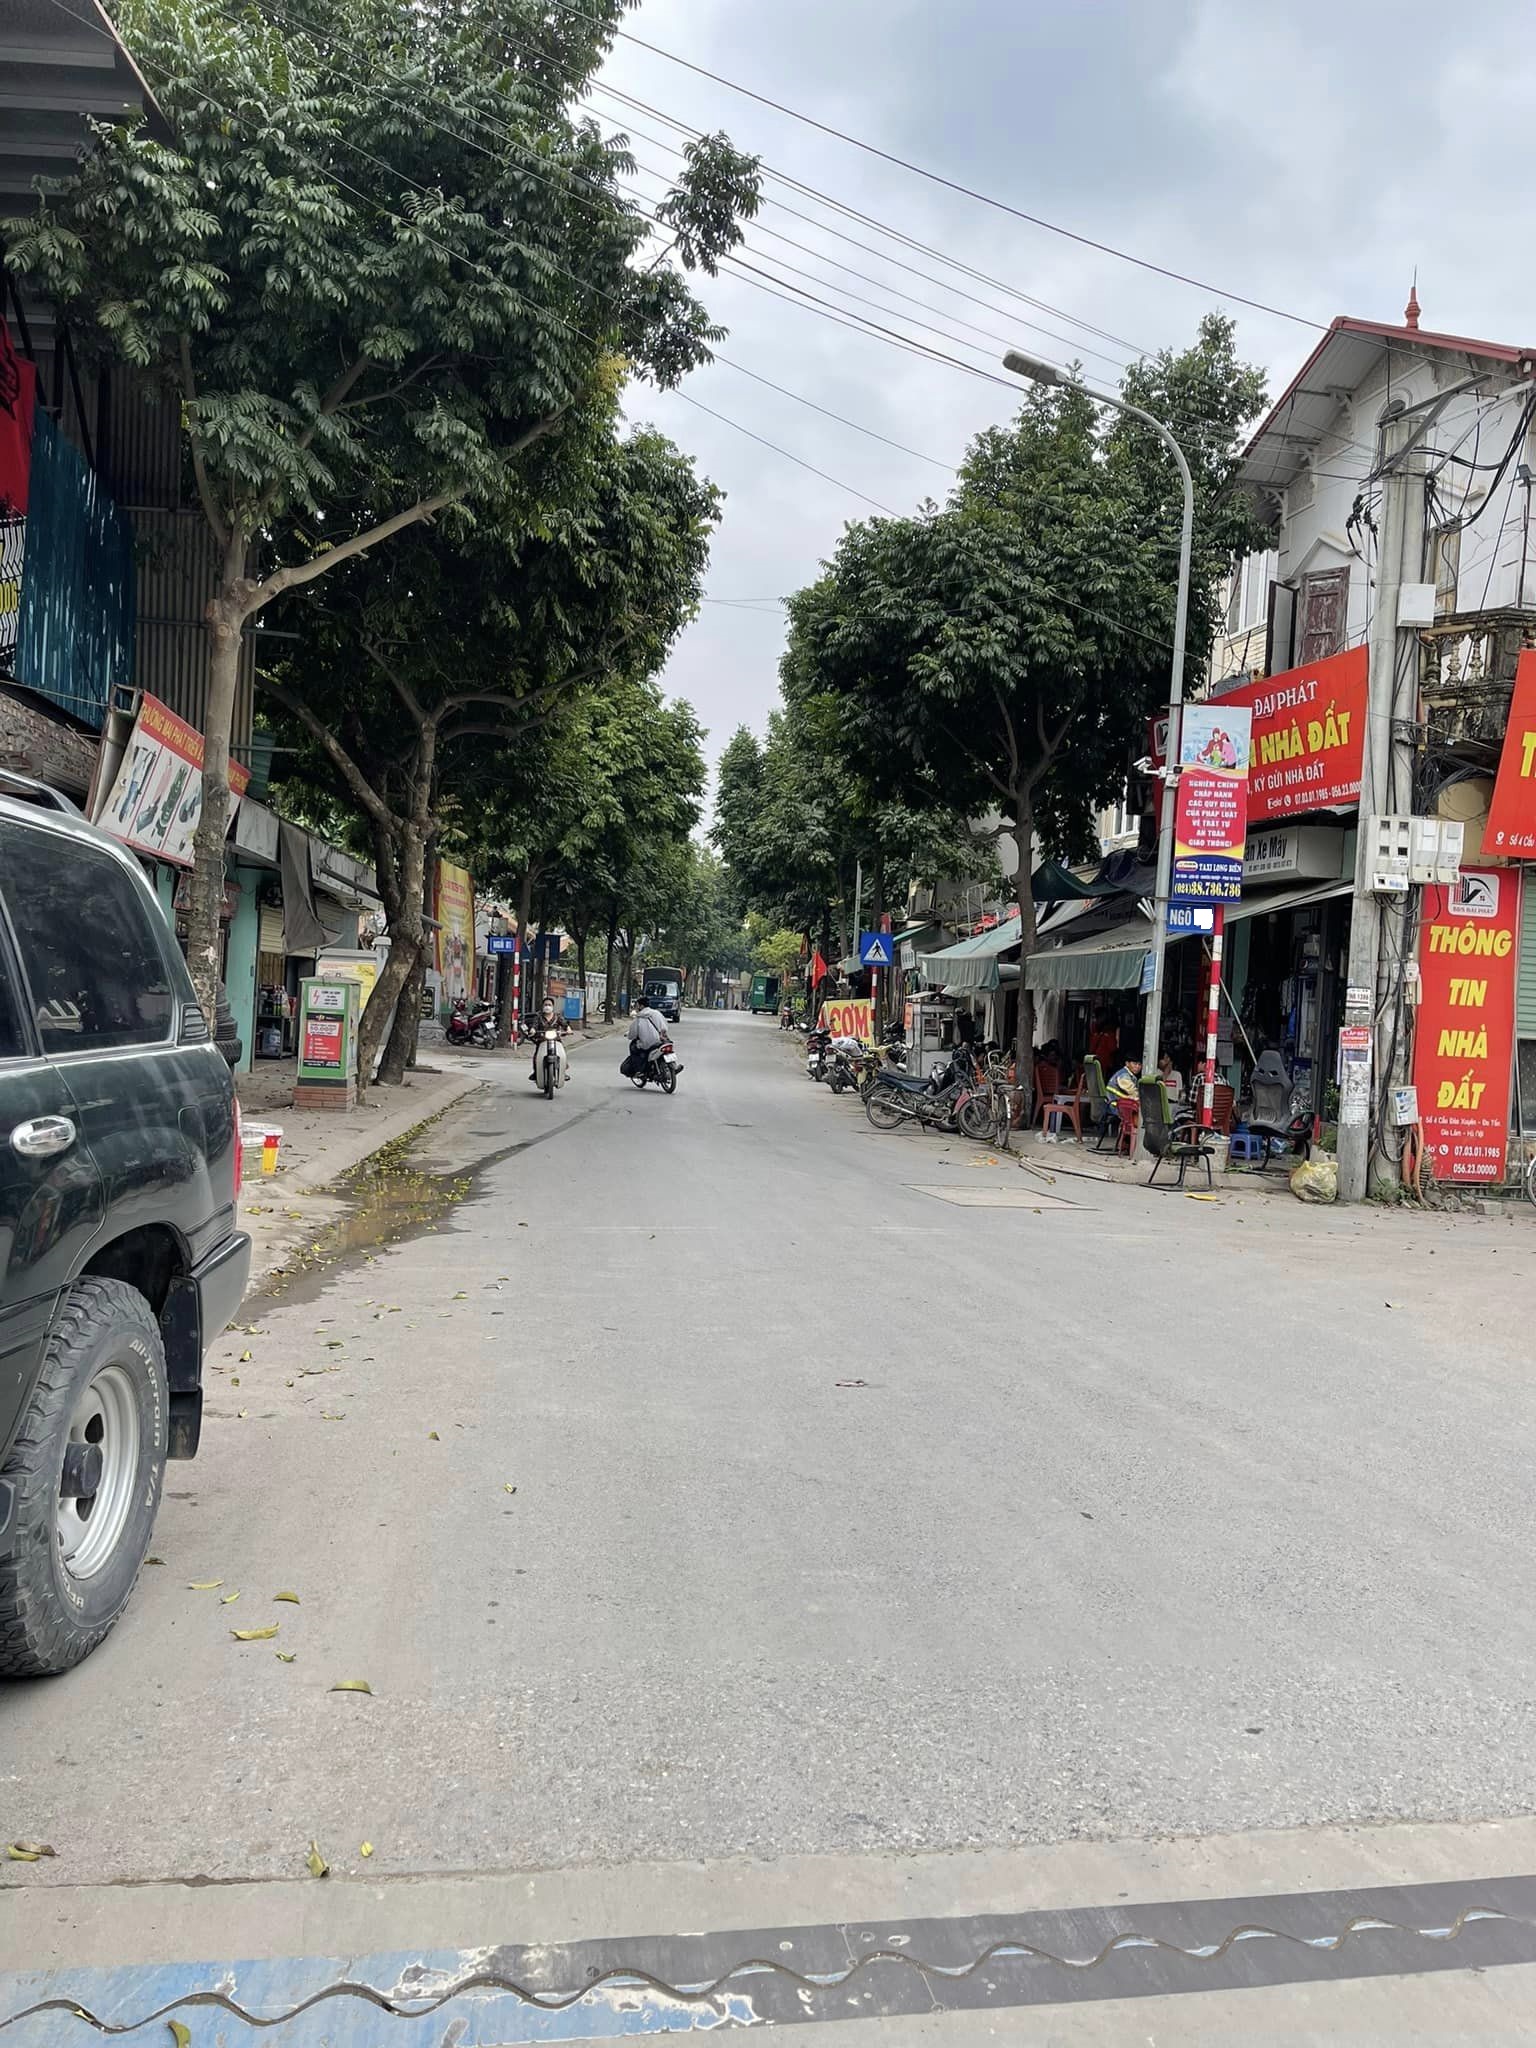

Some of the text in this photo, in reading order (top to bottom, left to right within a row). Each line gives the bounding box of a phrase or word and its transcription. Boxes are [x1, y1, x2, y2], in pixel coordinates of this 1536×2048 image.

[1277, 680, 1318, 710] PHÁT
[1260, 718, 1305, 765] NHÀ
[1308, 699, 1350, 753] ĐẤT
[1254, 772, 1266, 793] KÝ
[1267, 768, 1283, 790] GỬI
[1285, 764, 1305, 786] NHÀ
[1306, 758, 1325, 781] ĐẤT
[1188, 838, 1205, 847] GIAO
[1196, 829, 1206, 837] AN
[1256, 839, 1267, 860] Xe
[1269, 834, 1288, 860] Máy
[1199, 863, 1212, 872] TAXI
[1213, 863, 1228, 872] LONG
[1169, 906, 1192, 926] NGÕ
[1429, 920, 1512, 957] THÔNG
[1448, 978, 1488, 1007] TIN
[829, 1003, 870, 1039] CƠM
[1437, 1023, 1488, 1059] NHÀ
[1437, 1068, 1486, 1110] ĐẤT
[1454, 1145, 1500, 1158] 07.03.01.1985
[1453, 1163, 1497, 1175] 056.23.00000
[144, 1462, 159, 1508] T/A
